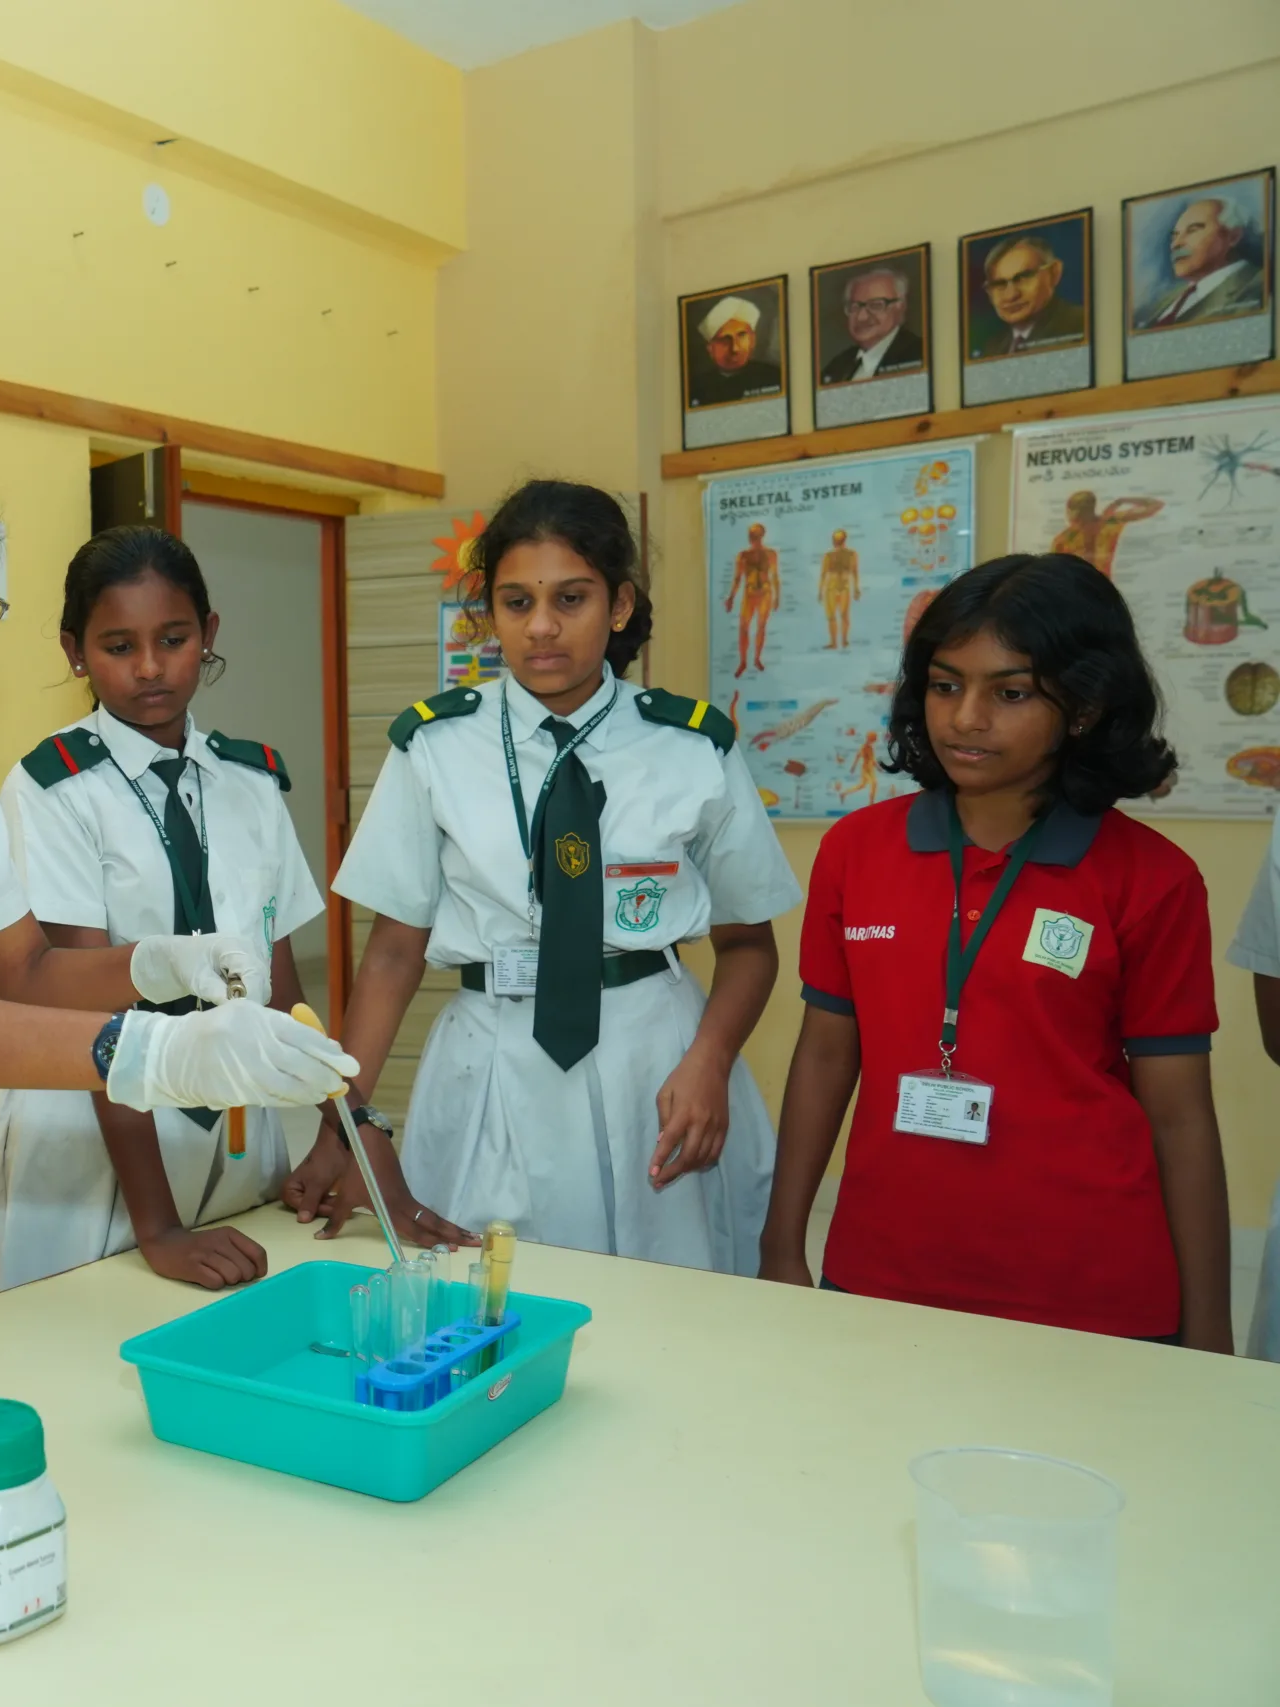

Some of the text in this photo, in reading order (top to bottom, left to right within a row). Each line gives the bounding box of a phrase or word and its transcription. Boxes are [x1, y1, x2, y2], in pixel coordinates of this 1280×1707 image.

[1026, 443, 1113, 468] NERVOUS
[1118, 435, 1195, 459] SYSTEM
[719, 482, 863, 510] SKELETAL SYSTEM
[504, 735, 513, 757] PUBLIC
[545, 761, 559, 783] DELHI
[556, 742, 575, 763] PUBLIC
[571, 725, 591, 746] SCHOOL
[508, 757, 517, 777] DELHI
[142, 797, 157, 818] PUBLIC
[155, 819, 167, 838] DELHI
[936, 1083, 955, 1091] PUBLIC
